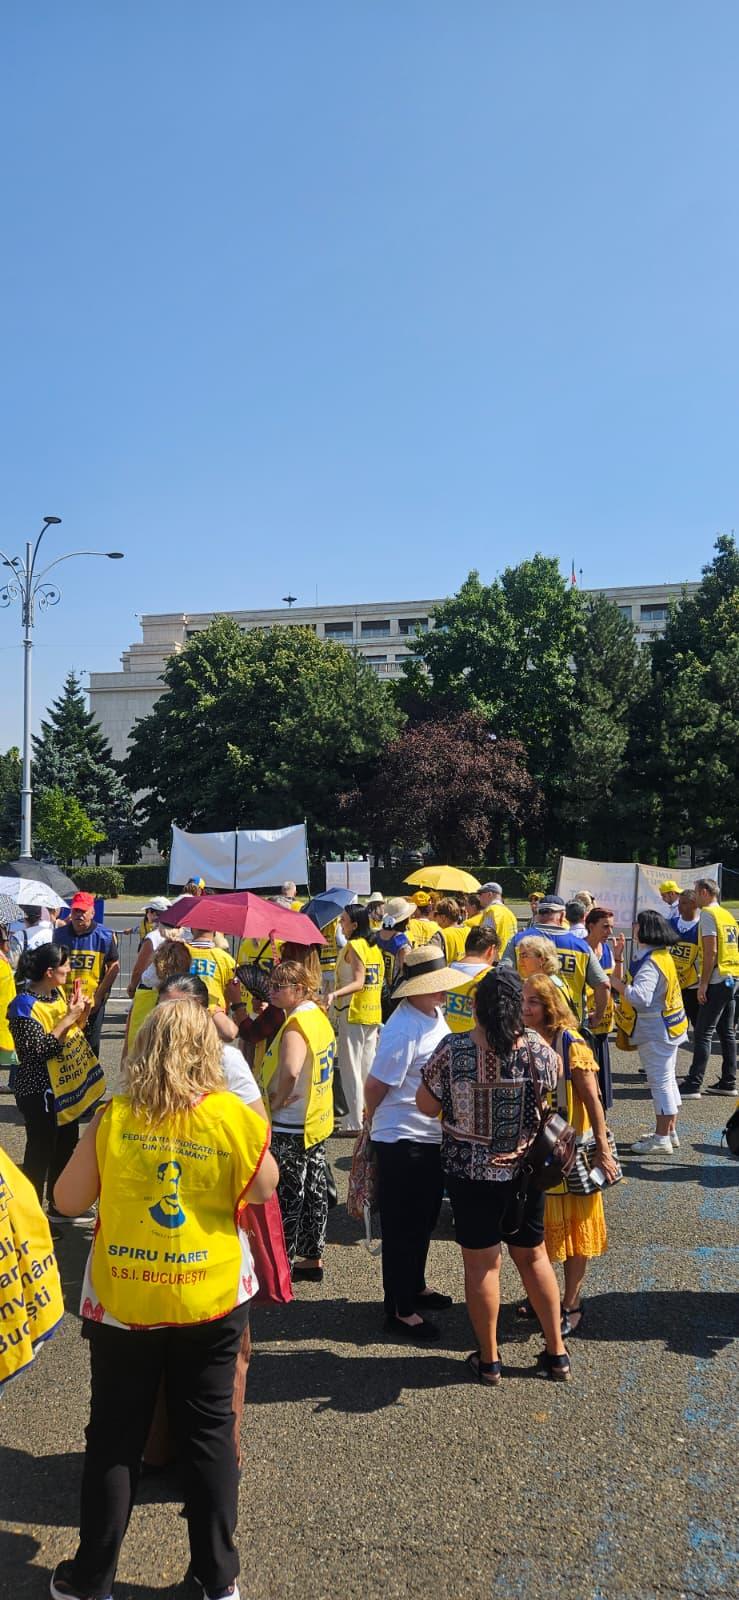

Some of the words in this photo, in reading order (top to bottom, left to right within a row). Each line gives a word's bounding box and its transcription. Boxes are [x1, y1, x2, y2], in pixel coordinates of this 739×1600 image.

[142, 1143, 158, 1151] DIN
[108, 1245, 158, 1261] SPIRU
[164, 1250, 208, 1263] HARET
[111, 1266, 138, 1281] S.S.I.
